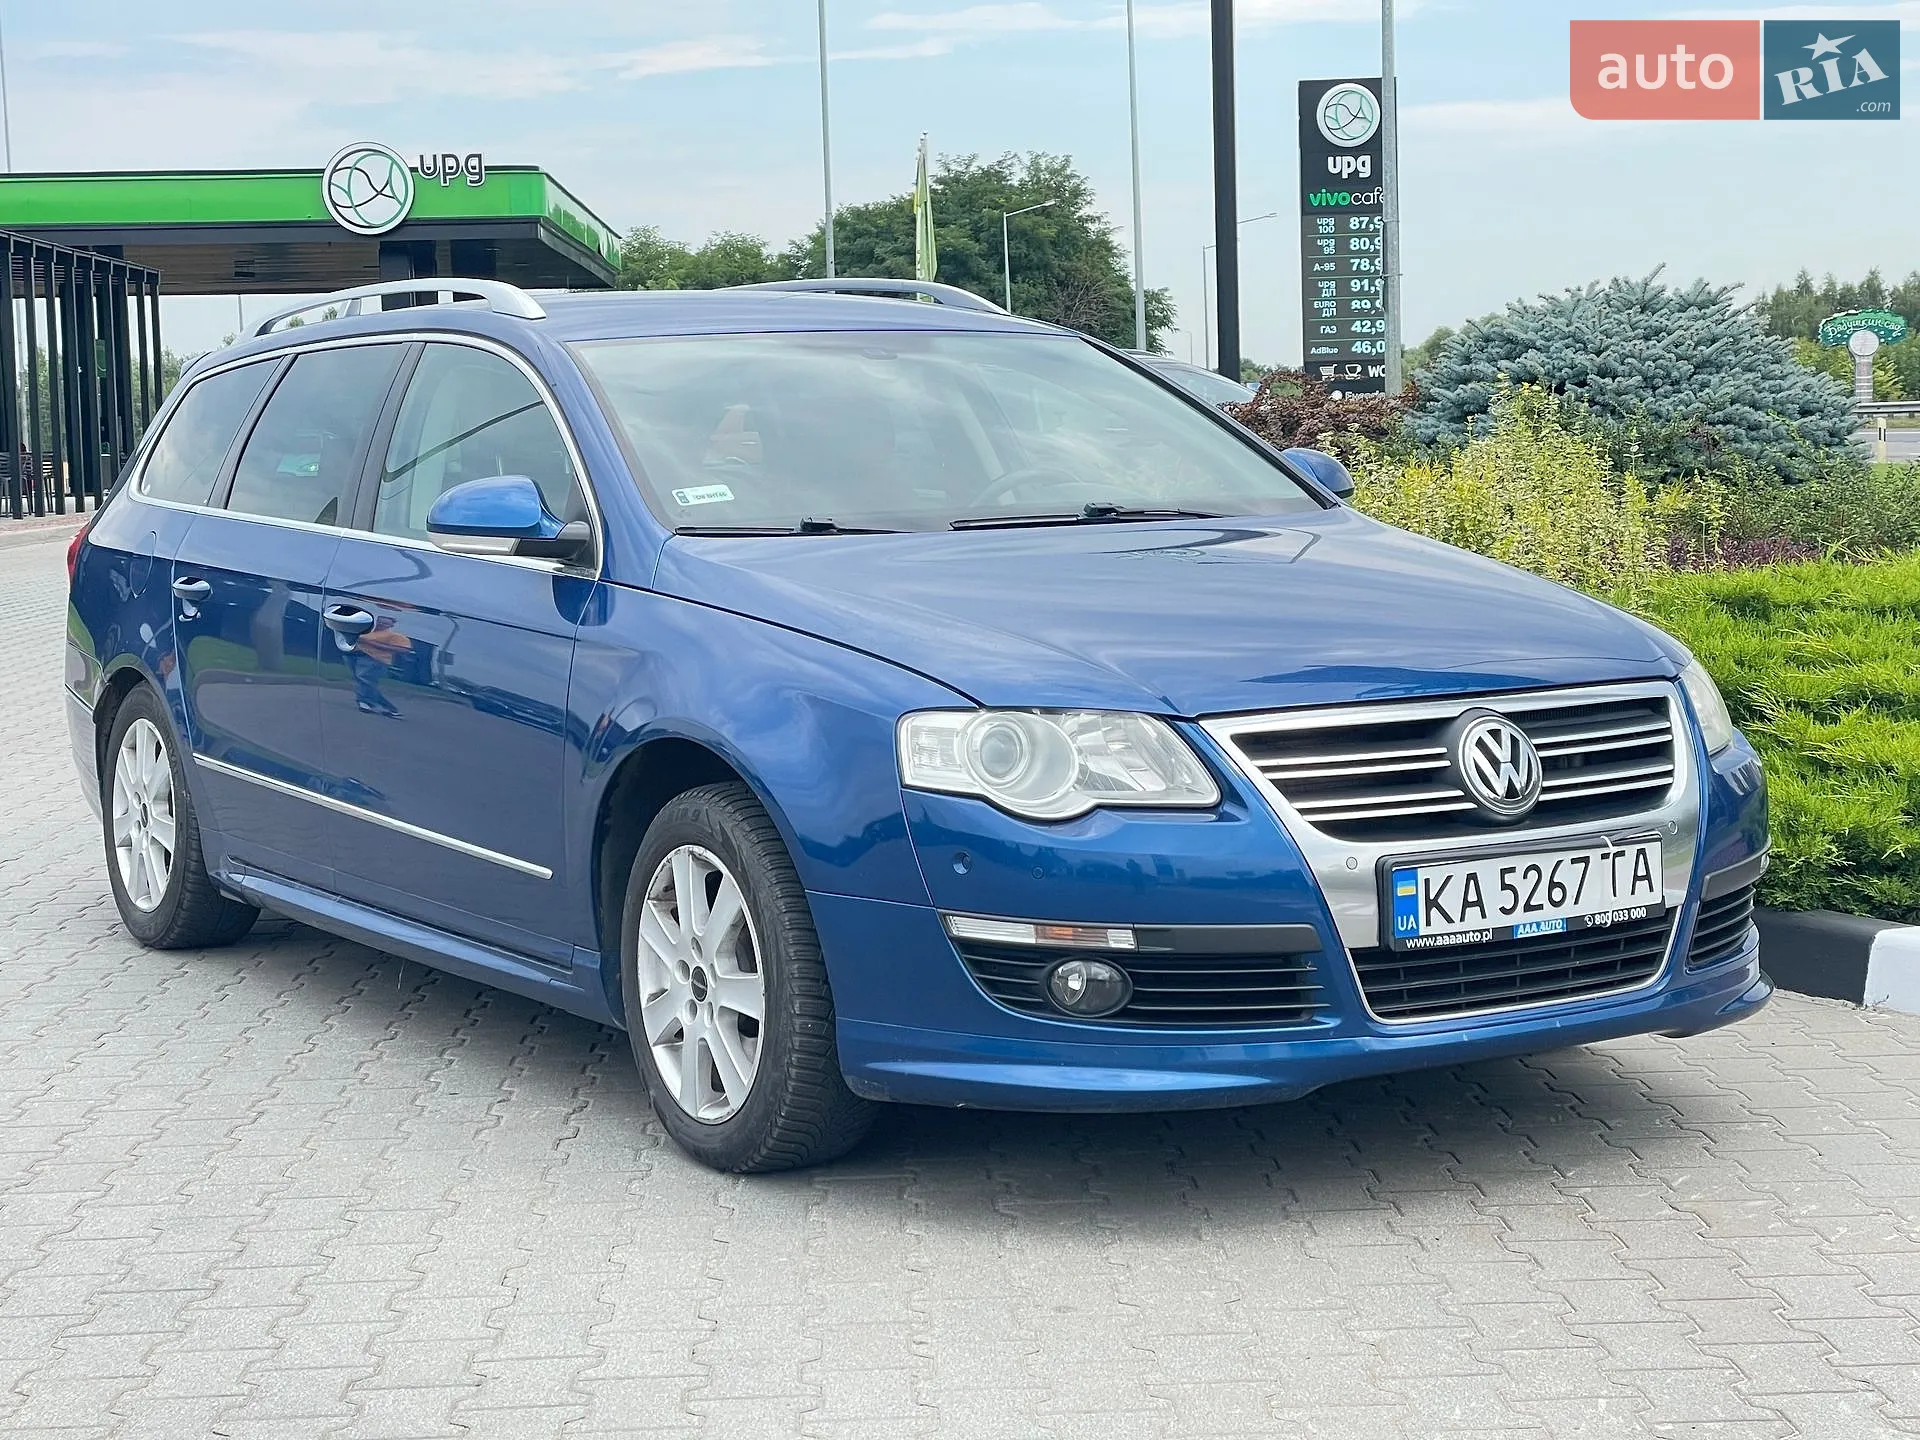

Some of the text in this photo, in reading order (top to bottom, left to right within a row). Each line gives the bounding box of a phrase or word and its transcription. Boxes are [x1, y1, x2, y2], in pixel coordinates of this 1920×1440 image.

[418, 152, 485, 186] upg
[1327, 155, 1371, 179] upg
[1316, 217, 1335, 226] upg
[1349, 216, 1384, 231] 87,9
[1318, 225, 1335, 234] 100
[1317, 239, 1335, 247] upg
[1323, 246, 1336, 254] 95
[1349, 237, 1383, 252] 80,9
[1349, 258, 1383, 273] 78,9
[1318, 280, 1336, 289] upg
[1350, 278, 1384, 293] 91,9
[1313, 301, 1337, 309] EURO
[1319, 325, 1337, 334] ГАЗ
[1350, 319, 1385, 335] 42,9
[1310, 346, 1339, 354] AdBlue
[1351, 340, 1385, 356] 46,0
[1424, 847, 1655, 928] KA 5267 TA
[1397, 914, 1417, 931] UA
[1594, 906, 1647, 926] 800 033 000
[1517, 919, 1563, 935] AAA AUTO
[1405, 927, 1493, 949] www.aaaauto.pl
